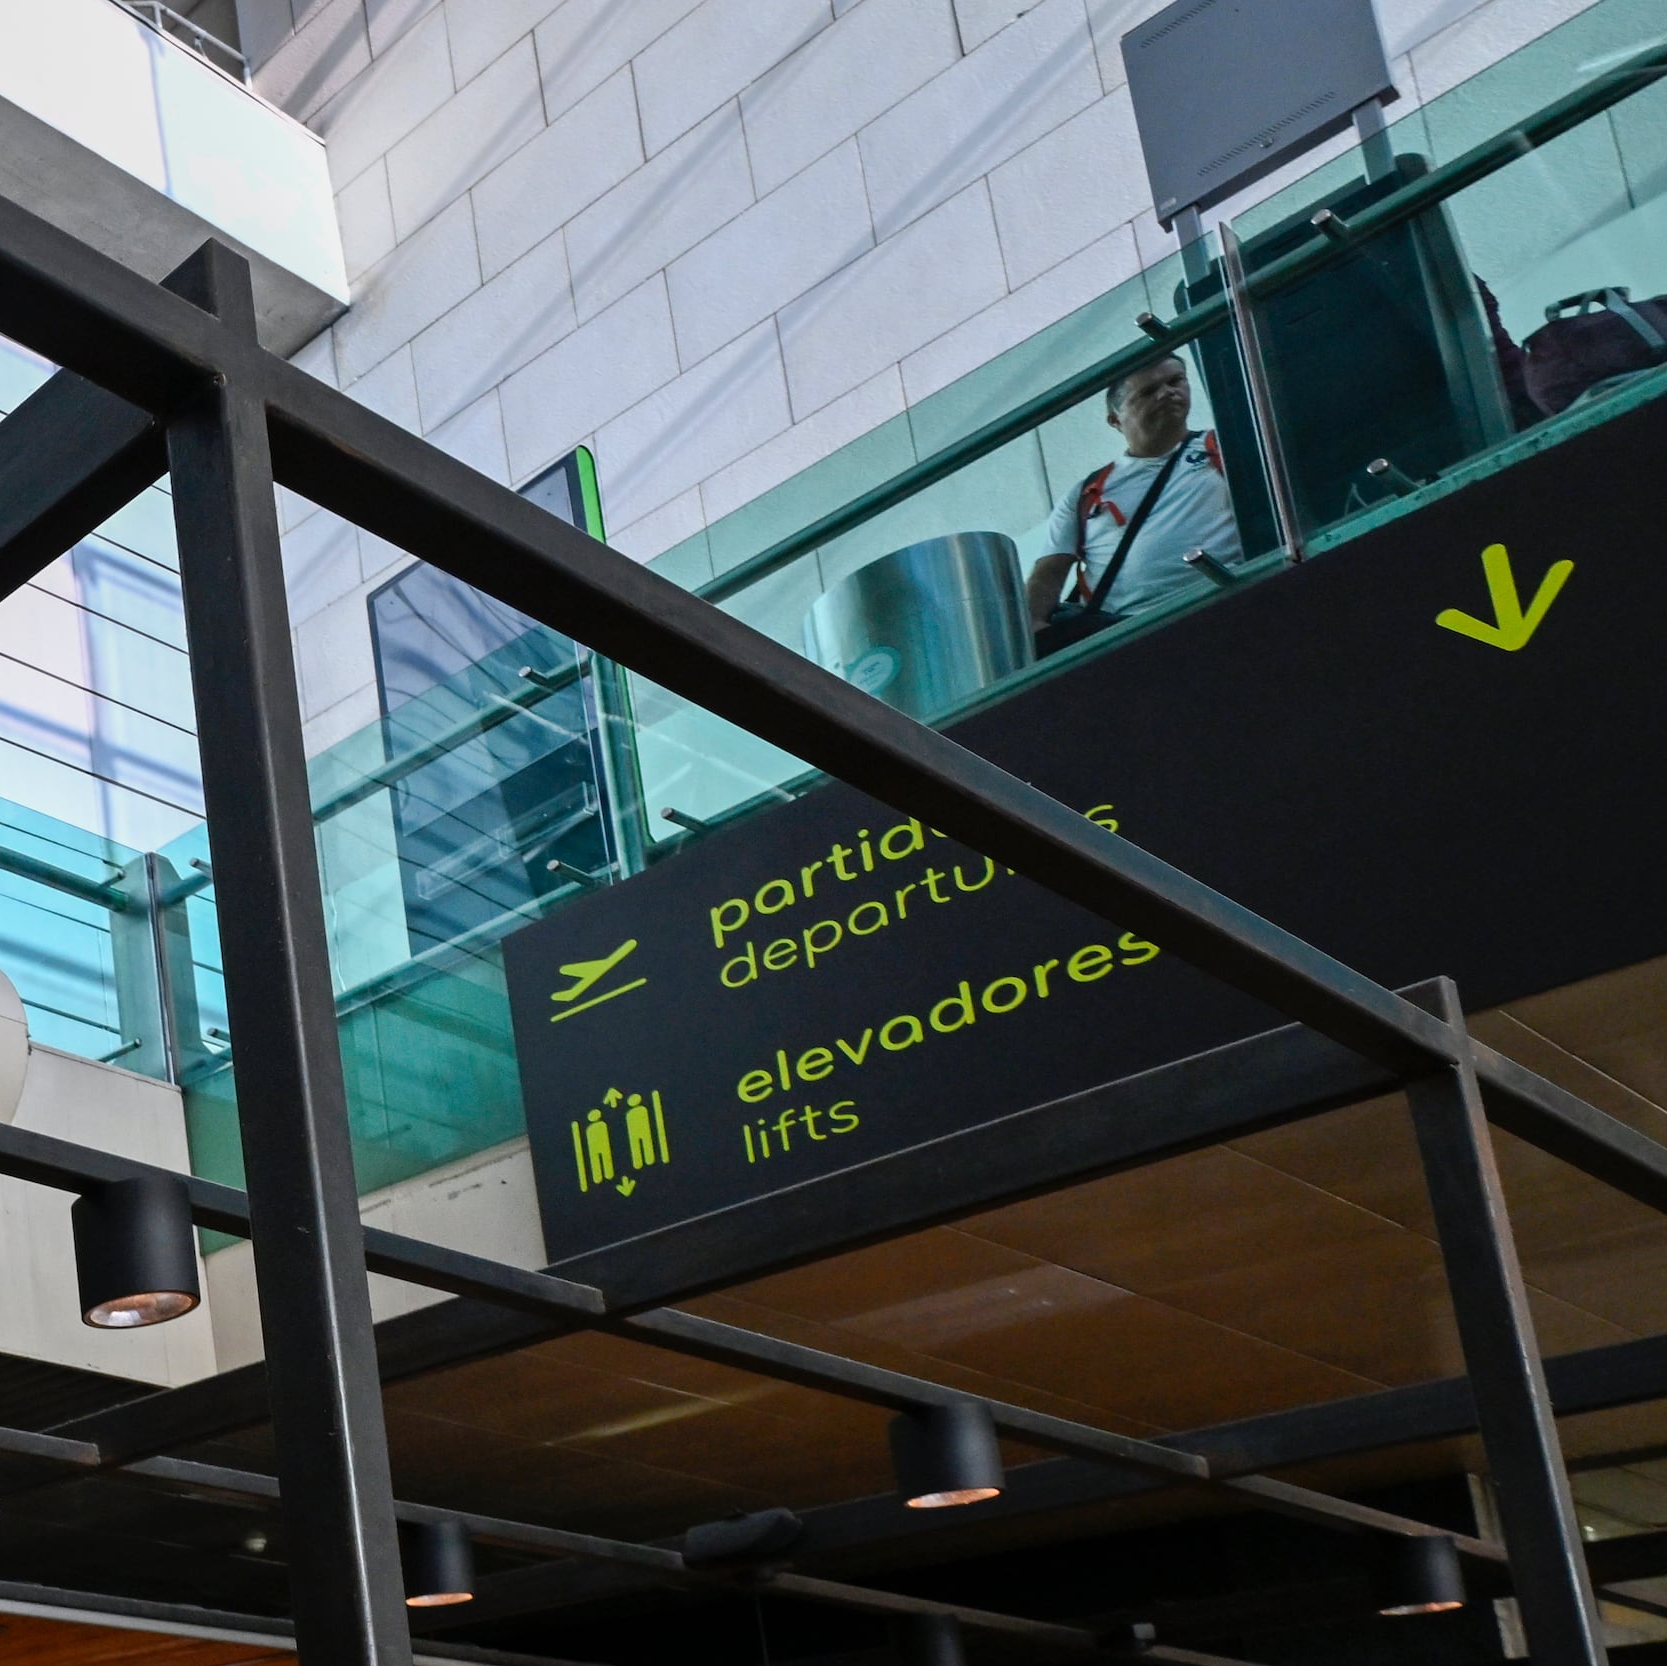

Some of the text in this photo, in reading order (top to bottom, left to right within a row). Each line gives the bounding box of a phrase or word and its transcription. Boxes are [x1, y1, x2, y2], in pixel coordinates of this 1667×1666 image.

[710, 816, 947, 948] partid
[737, 931, 1161, 1103] elevadores
[743, 1100, 860, 1164] lifts
